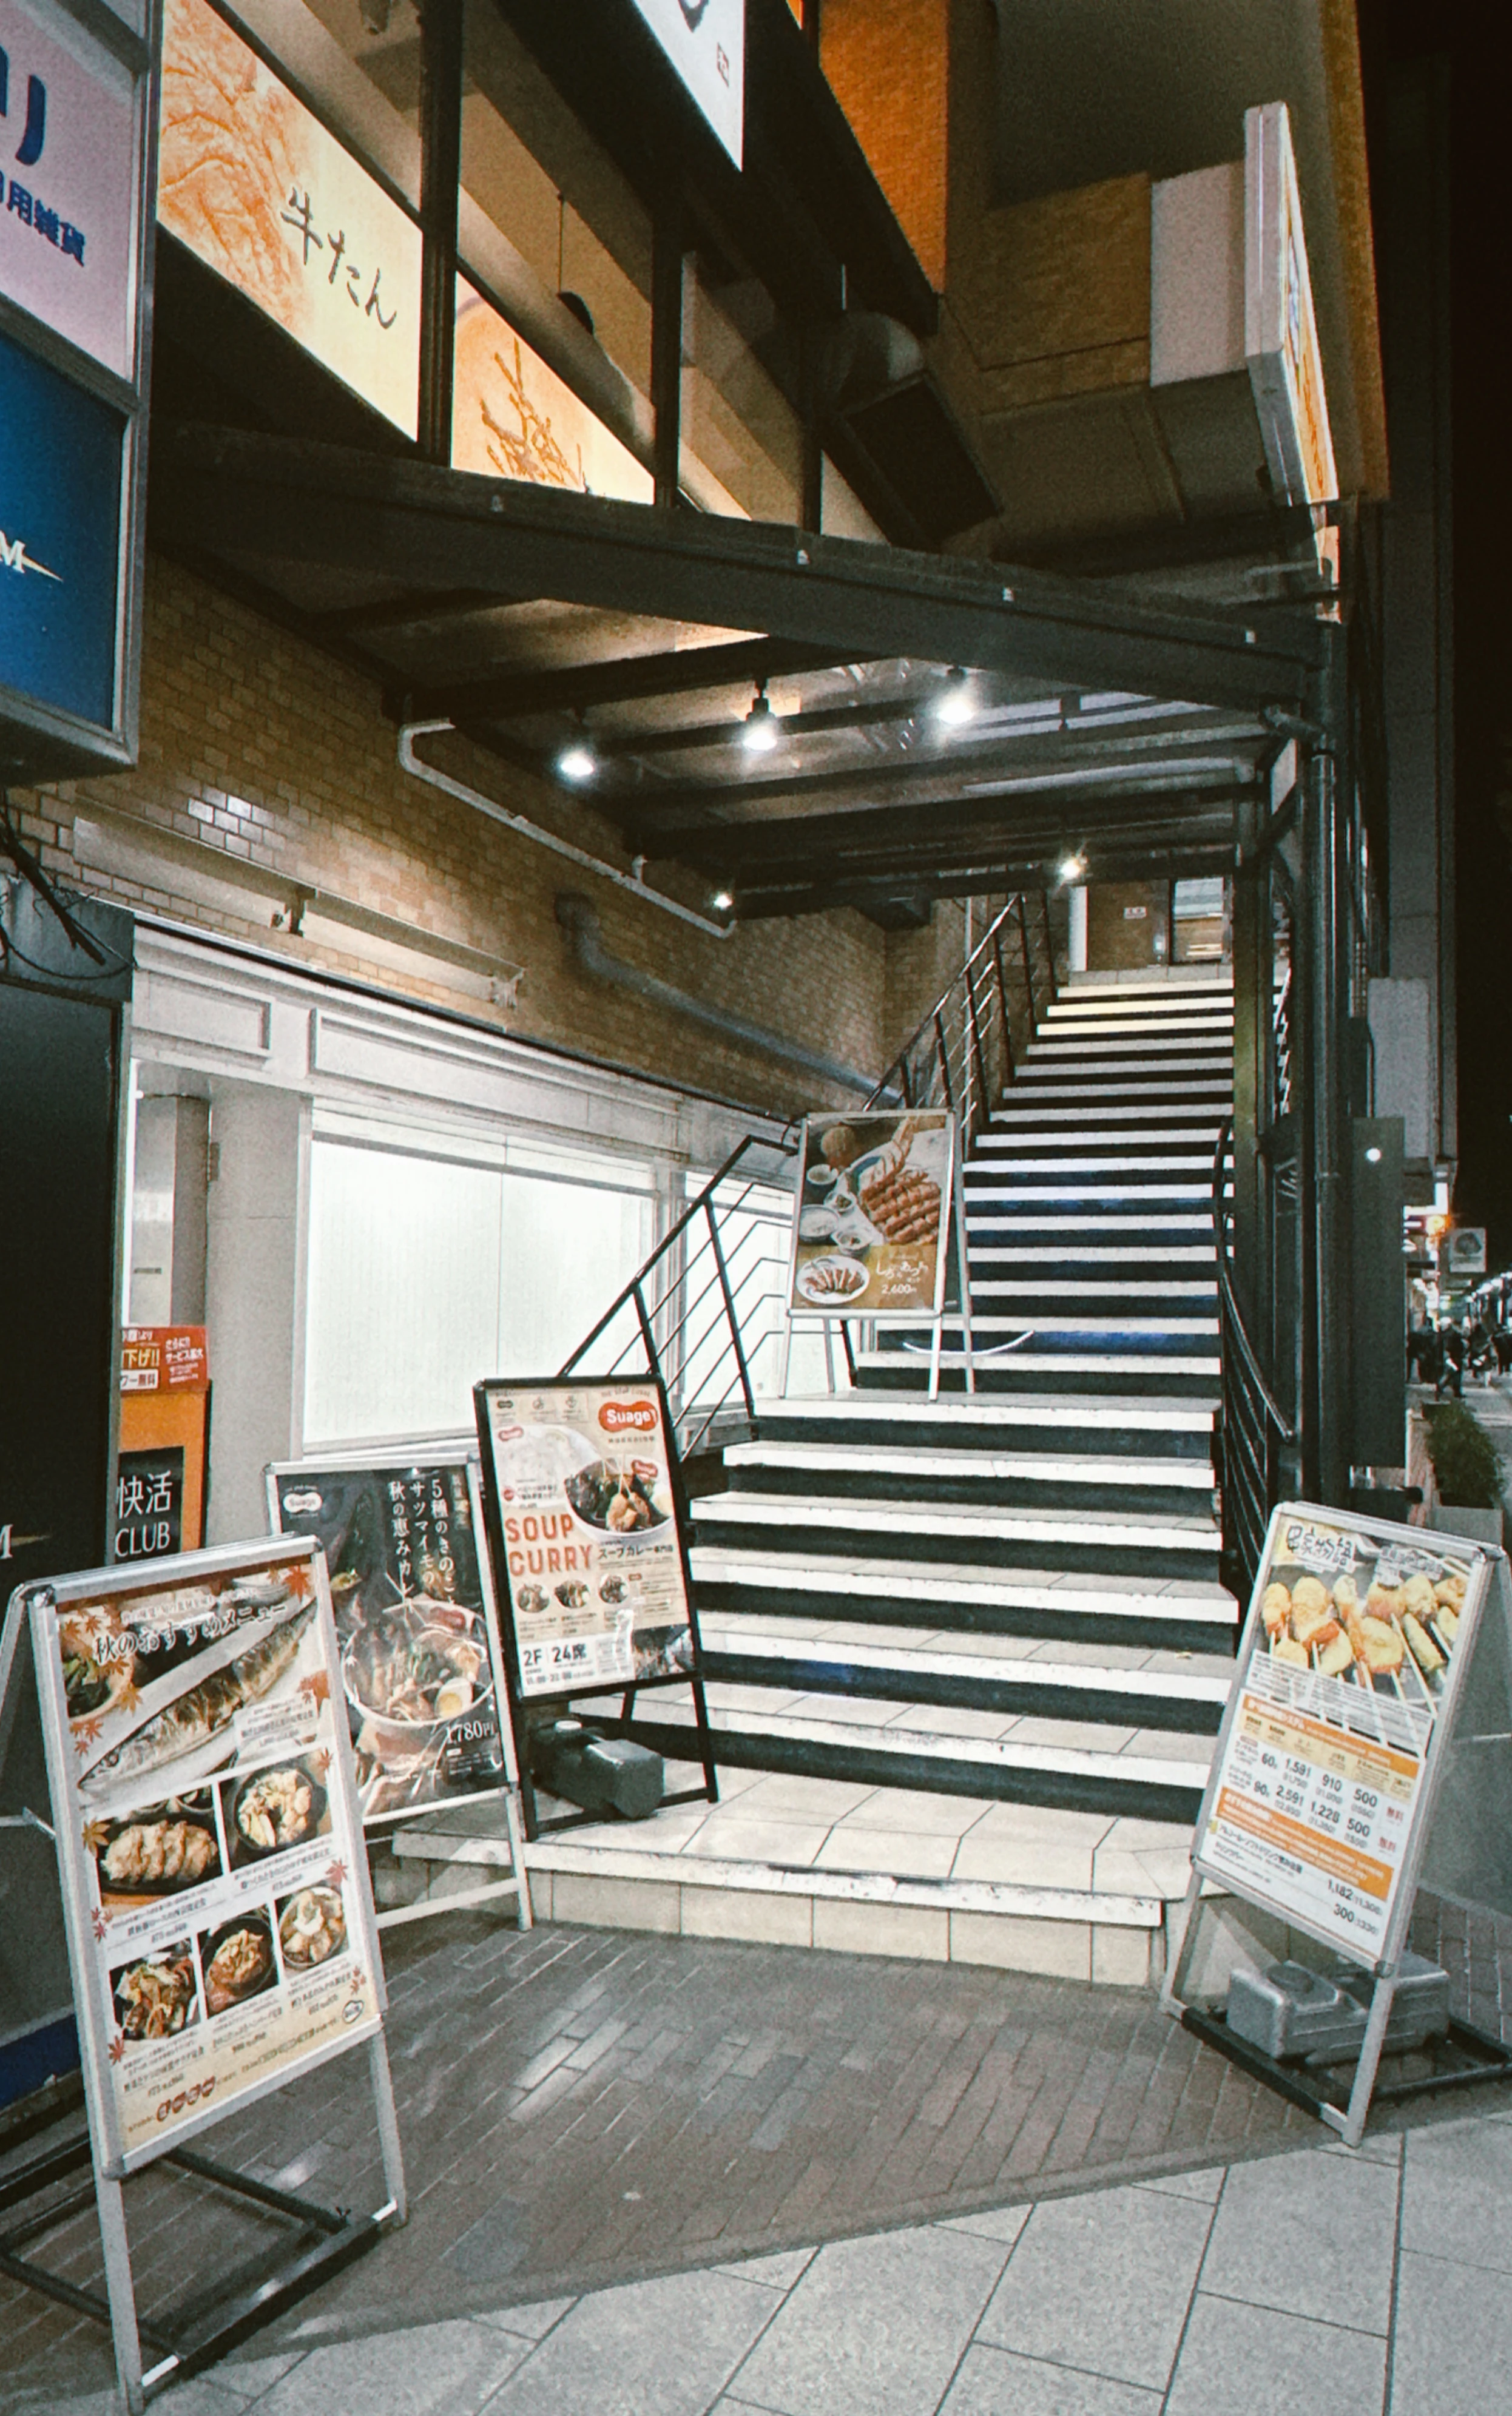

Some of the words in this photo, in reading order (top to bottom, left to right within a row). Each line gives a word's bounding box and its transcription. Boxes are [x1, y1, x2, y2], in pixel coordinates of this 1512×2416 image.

[0, 170, 85, 267] 用雑貨
[282, 186, 396, 329] 牛たん
[115, 1470, 173, 1519] 快活
[115, 1521, 170, 1558] CLUB
[504, 1514, 574, 1544] SOUP
[508, 1544, 592, 1577] CURRY
[524, 1648, 542, 1667] 2F
[1322, 1773, 1342, 1792] 910
[1354, 1788, 1377, 1807] 500
[1347, 1818, 1370, 1838] 500
[1334, 1903, 1354, 1923] 300
